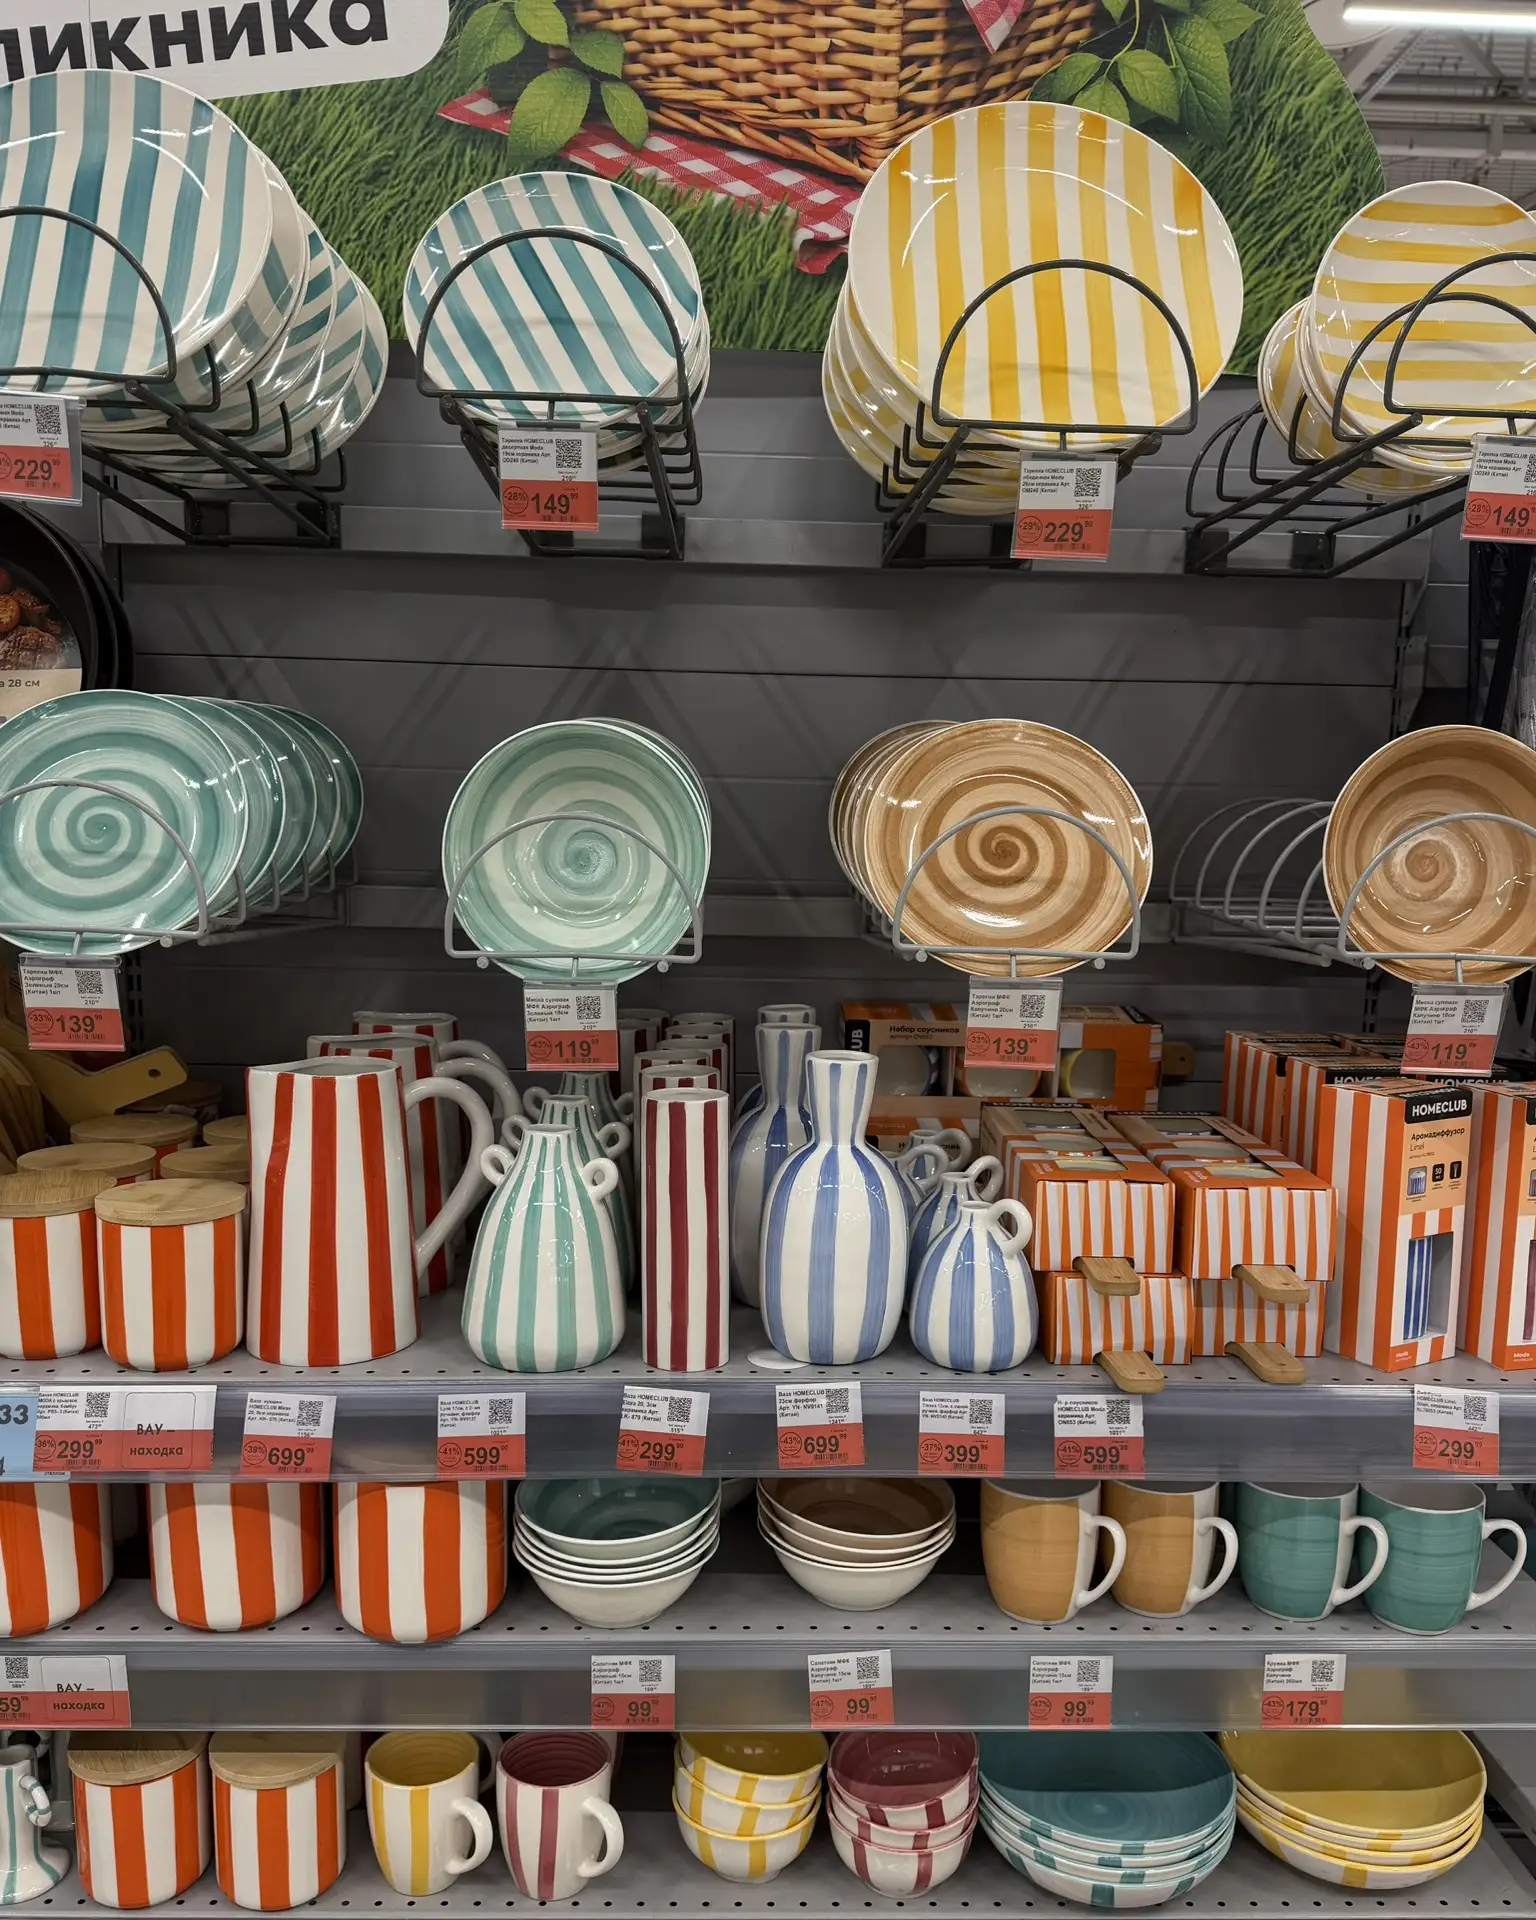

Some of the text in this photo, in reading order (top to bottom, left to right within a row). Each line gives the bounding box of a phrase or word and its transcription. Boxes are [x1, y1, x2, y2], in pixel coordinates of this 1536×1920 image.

[14, 459, 52, 481] 229
[505, 492, 526, 501] -28%
[531, 493, 570, 515] 149
[1469, 504, 1530, 528] -28% 149
[1020, 523, 1040, 531] -29%
[1044, 522, 1083, 543] 229
[8, 679, 22, 688] 28
[25, 680, 40, 688] см
[56, 1015, 94, 1033] 139
[889, 1025, 960, 1034] Набор соусников
[555, 1040, 591, 1058] 119
[969, 1036, 988, 1044] -33%
[993, 1037, 1028, 1055] 139
[1432, 1043, 1467, 1061] 119
[1412, 1099, 1467, 1116] HOMECLUB
[1411, 1127, 1465, 1141] Аромадиффузор
[1410, 1143, 1425, 1151] Linel
[137, 1424, 163, 1436] ВАУ
[57, 1440, 94, 1459] 299
[130, 1447, 183, 1457] находка
[640, 1441, 675, 1461] 299
[804, 1435, 840, 1454] 699
[922, 1444, 941, 1452] -37%
[944, 1444, 980, 1463] 399
[1417, 1436, 1435, 1445] -32%
[1438, 1439, 1475, 1459] 299
[245, 1446, 265, 1454] -39%
[268, 1447, 305, 1466] 699
[464, 1447, 500, 1466] 599
[1083, 1446, 1120, 1464] 599
[57, 1683, 82, 1693] ВАУ
[53, 1702, 105, 1711] находка
[629, 1701, 651, 1717] 99
[847, 1698, 869, 1714] 99
[1064, 1701, 1086, 1717] 99
[1287, 1701, 1319, 1717] 179
